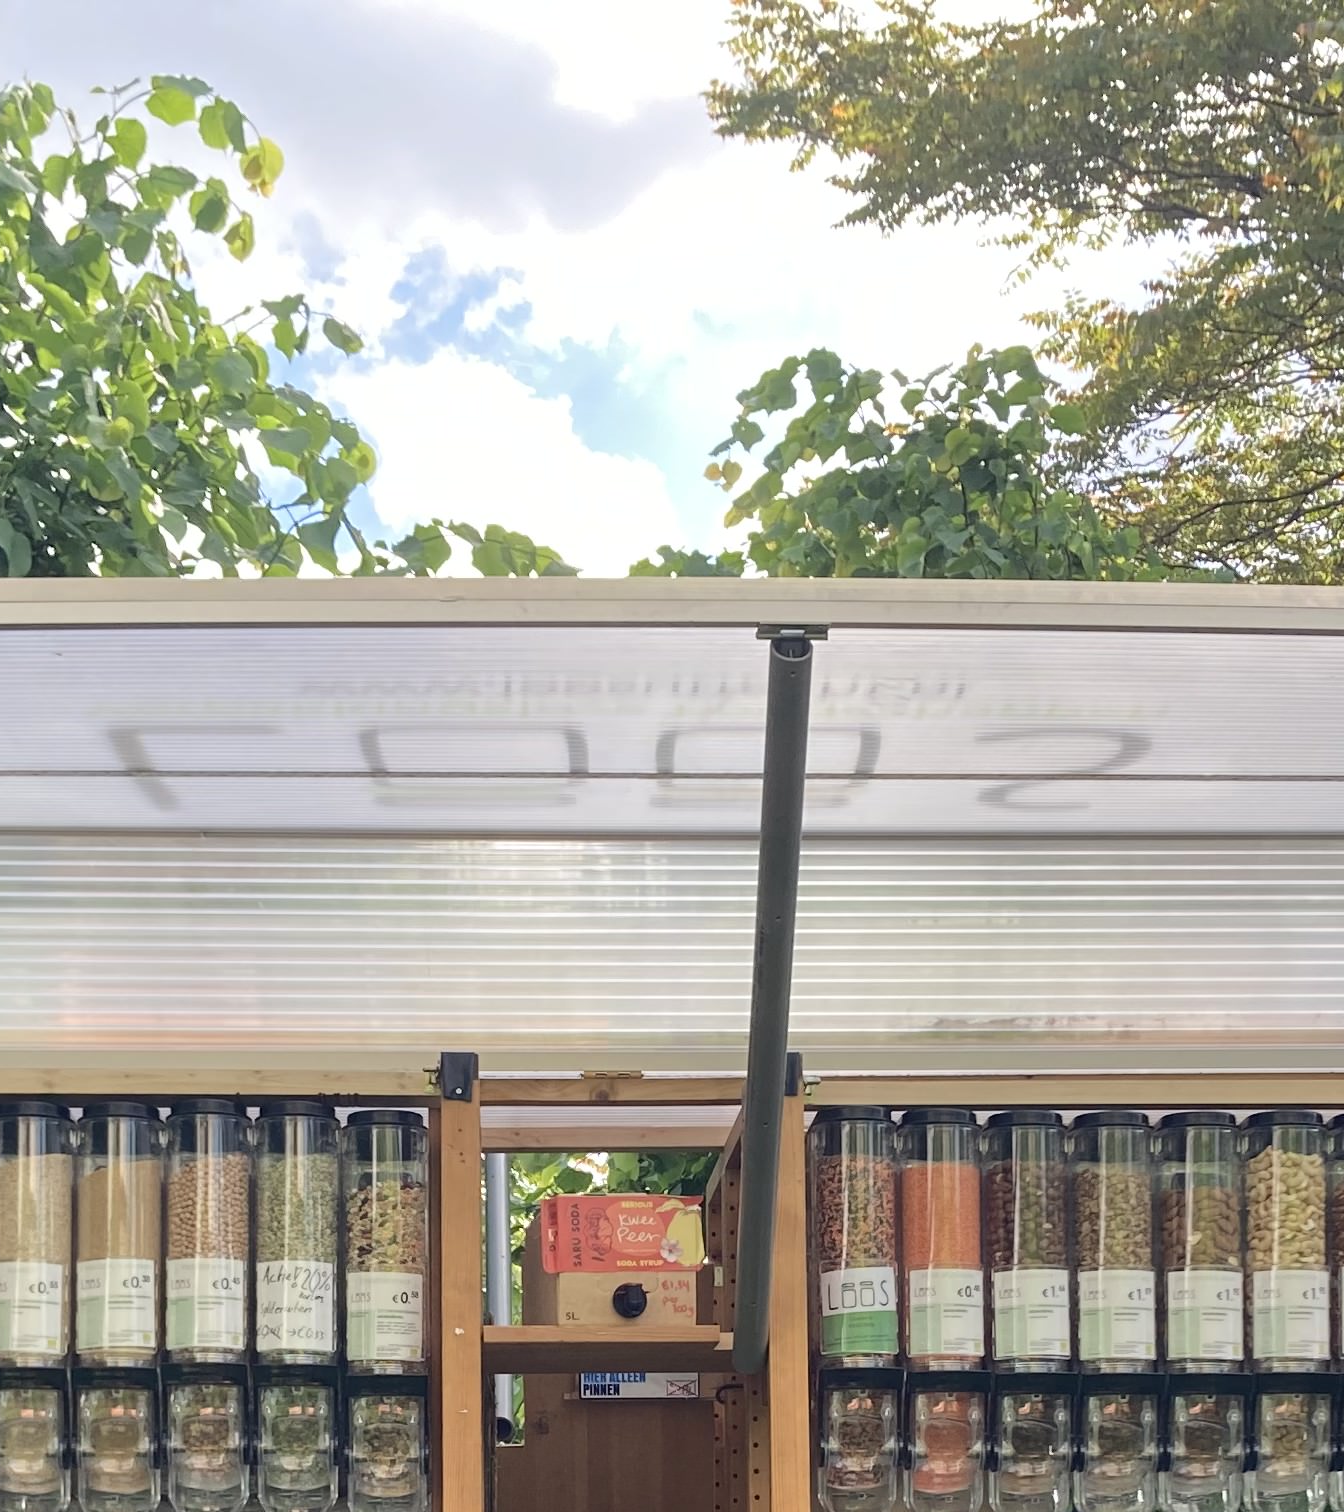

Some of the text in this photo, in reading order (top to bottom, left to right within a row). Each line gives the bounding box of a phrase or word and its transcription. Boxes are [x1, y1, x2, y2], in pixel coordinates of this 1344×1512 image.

[618, 1214, 657, 1226] Kwee
[570, 1203, 582, 1267] SARU SODA
[617, 1227, 662, 1243] Peer
[583, 1383, 620, 1396] PINNEN
